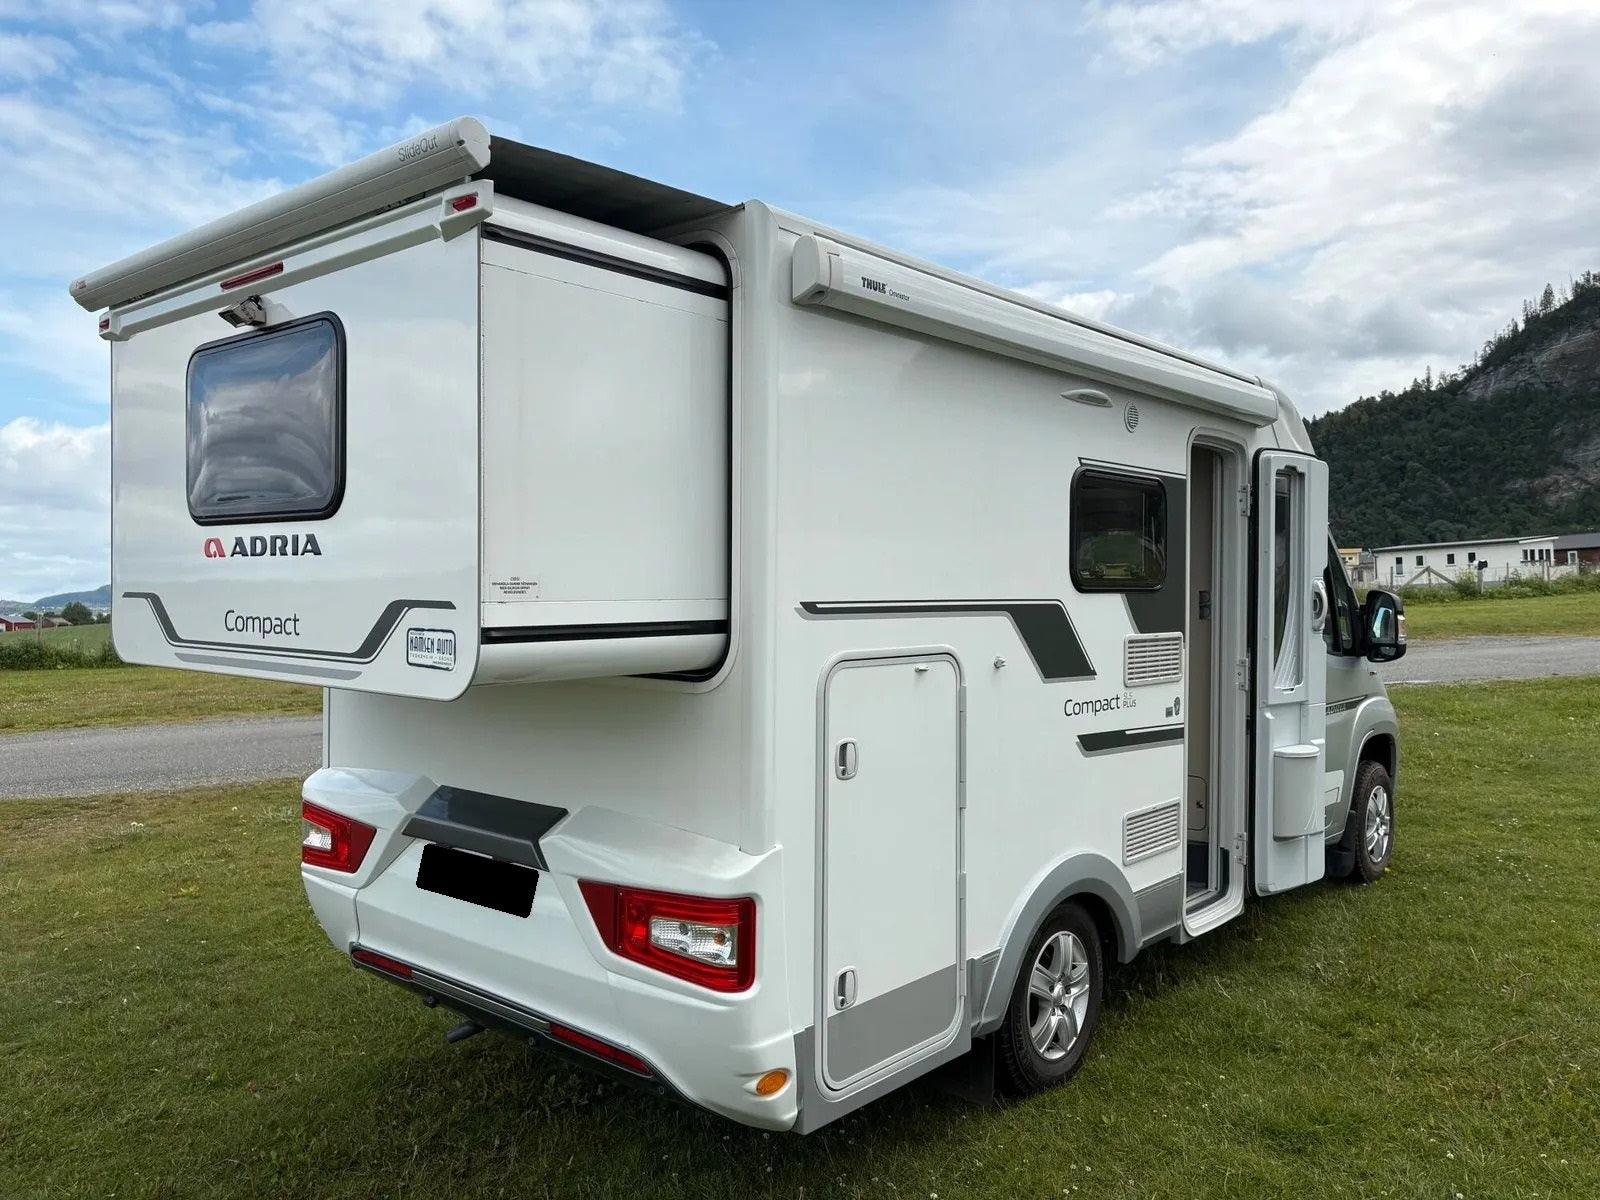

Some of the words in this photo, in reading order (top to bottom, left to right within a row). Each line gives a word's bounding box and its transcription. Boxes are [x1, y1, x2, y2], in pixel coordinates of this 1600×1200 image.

[398, 134, 439, 162] SlideOut
[861, 276, 887, 294] THULE
[230, 533, 323, 558] ADRIA
[224, 608, 301, 640] Compact
[436, 638, 453, 656] AUTO
[1063, 694, 1121, 717] Compact
[1122, 698, 1138, 709] PLUS
